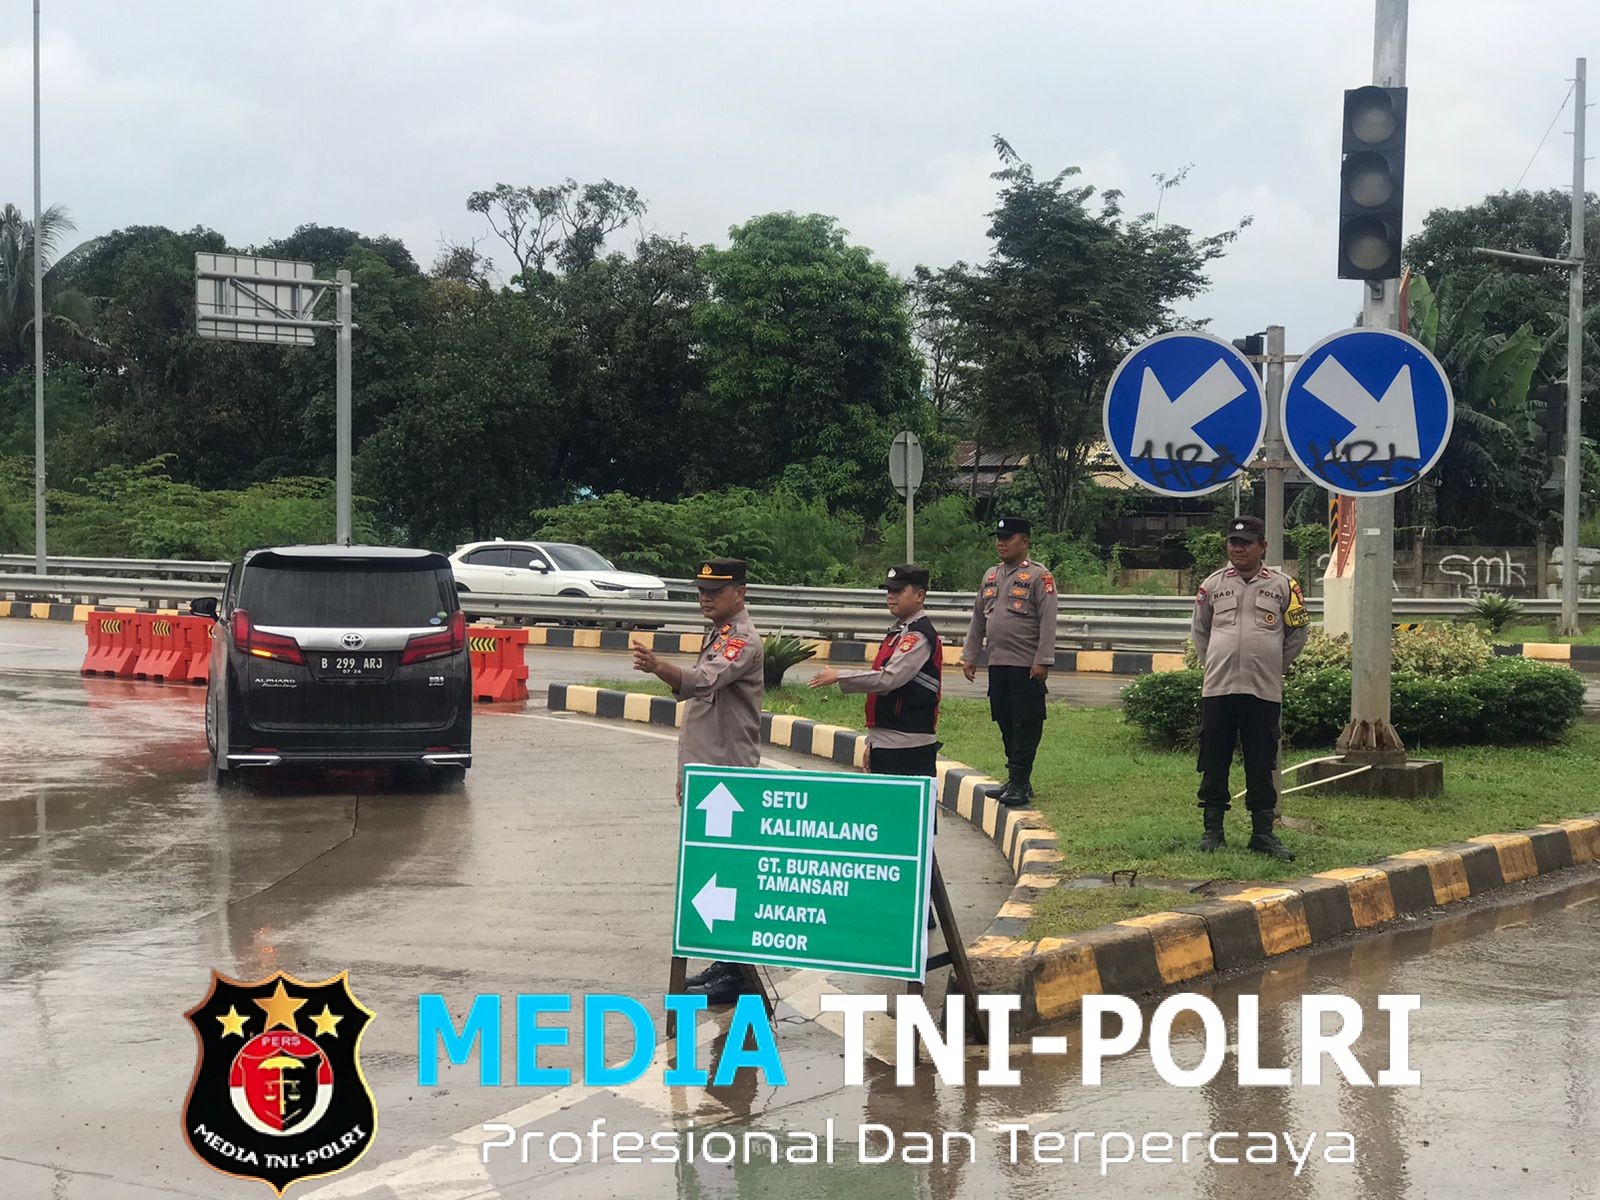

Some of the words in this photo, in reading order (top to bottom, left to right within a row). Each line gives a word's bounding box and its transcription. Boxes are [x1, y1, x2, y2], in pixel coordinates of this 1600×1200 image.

[1259, 589, 1282, 601] POLRI
[321, 657, 328, 669] B
[336, 657, 356, 669] 299
[363, 657, 383, 669] ARJ
[762, 790, 808, 810] SETU
[760, 818, 879, 842] KALIMALANG
[757, 857, 781, 875] GT.
[786, 859, 901, 882] BURANGKENG
[757, 875, 849, 897] TAMANSARI
[754, 904, 827, 925] JAKARTA
[751, 931, 808, 951] BOGOR
